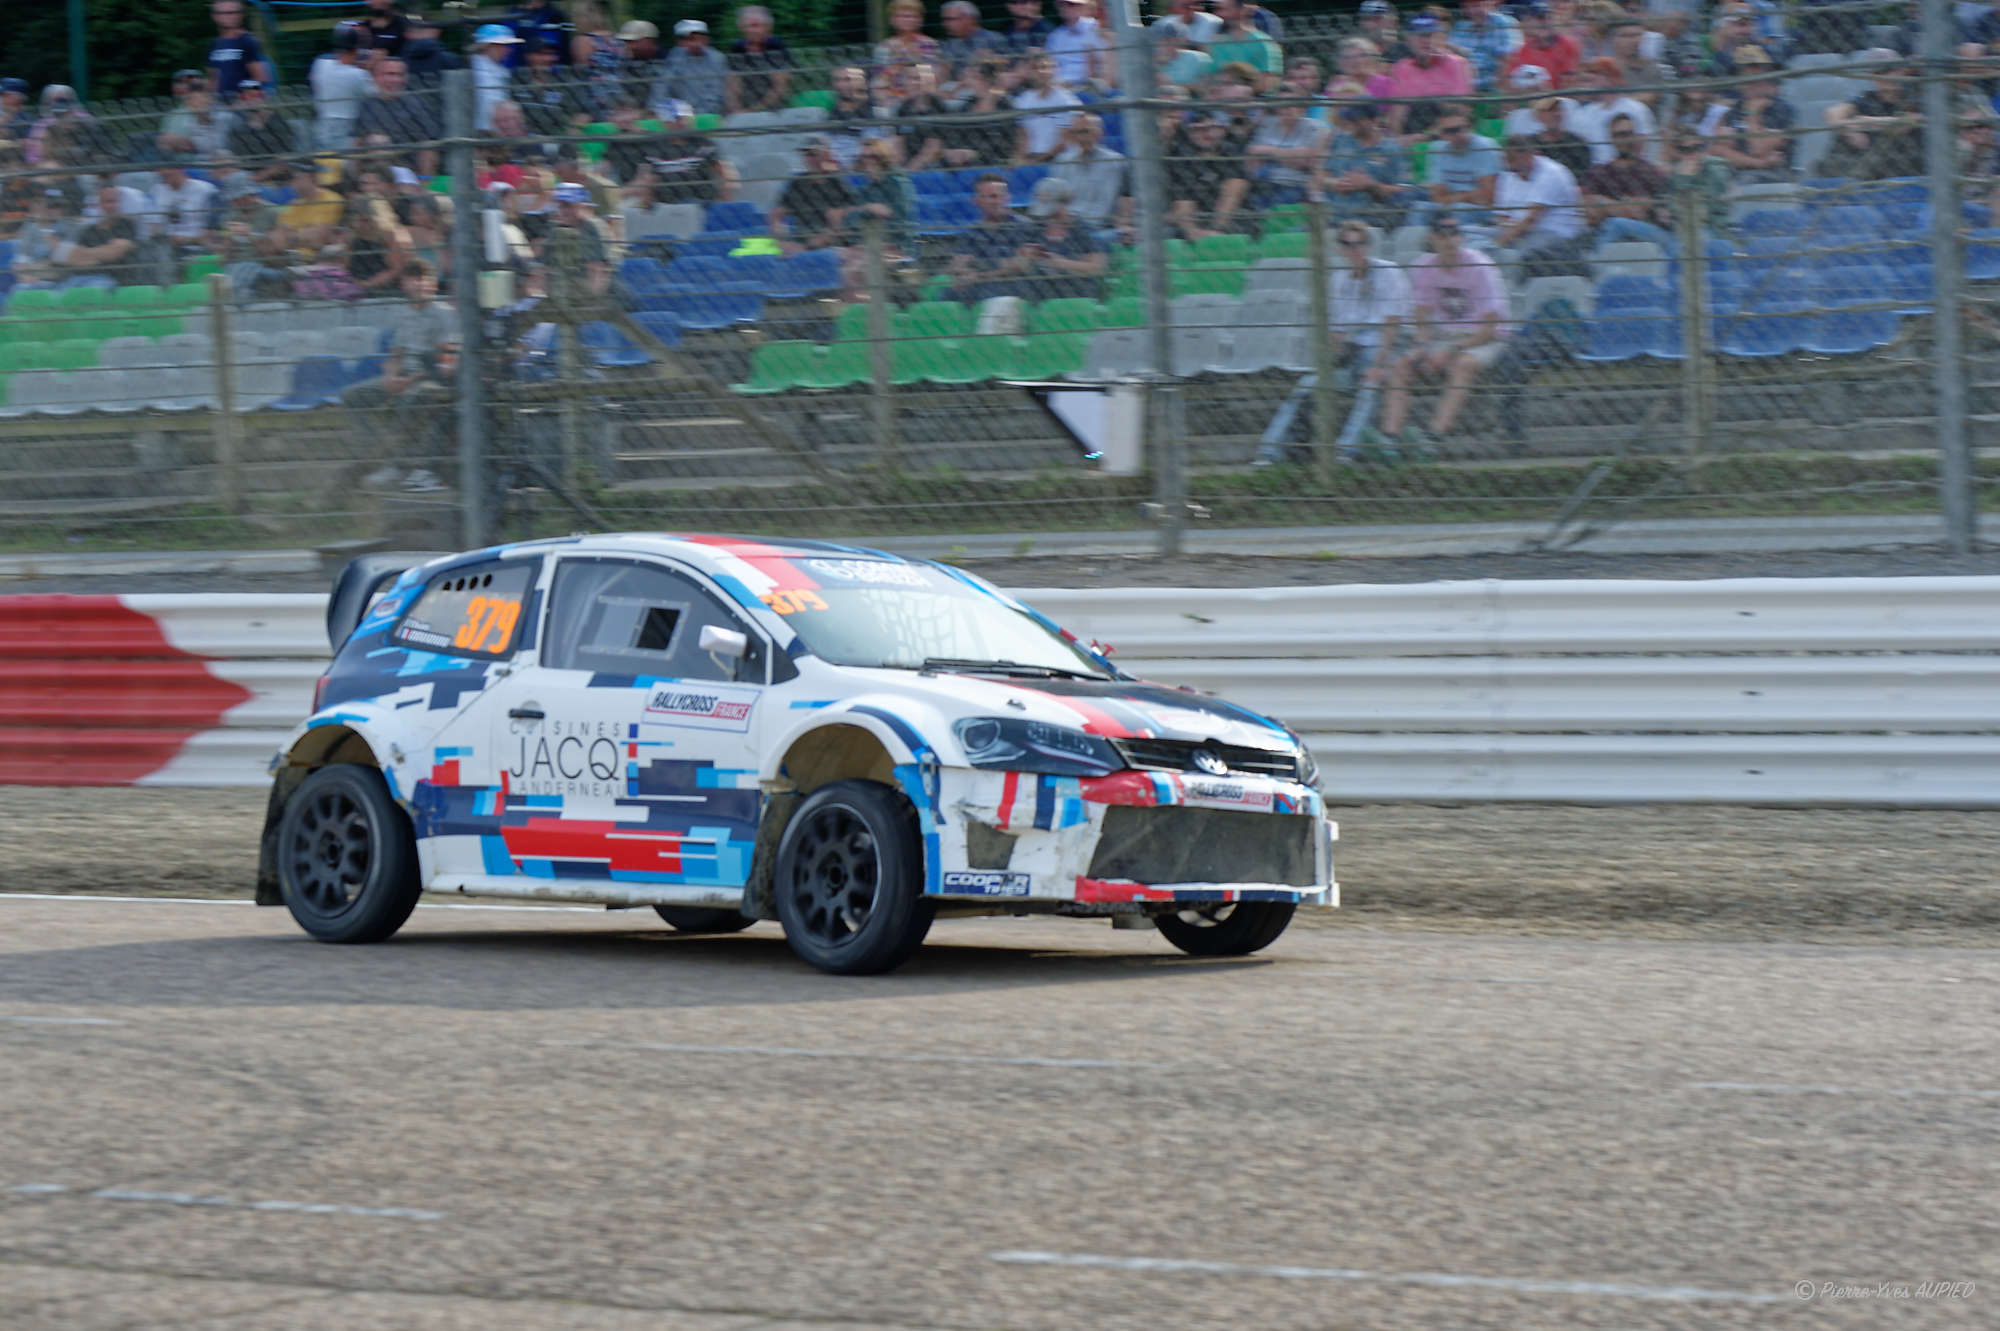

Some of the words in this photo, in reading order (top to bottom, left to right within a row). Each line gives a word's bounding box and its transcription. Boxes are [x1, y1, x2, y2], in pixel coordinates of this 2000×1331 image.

[760, 588, 829, 615] 379
[454, 595, 522, 654] 379
[651, 691, 719, 713] RALLYCROSS
[509, 736, 620, 781] JACQ
